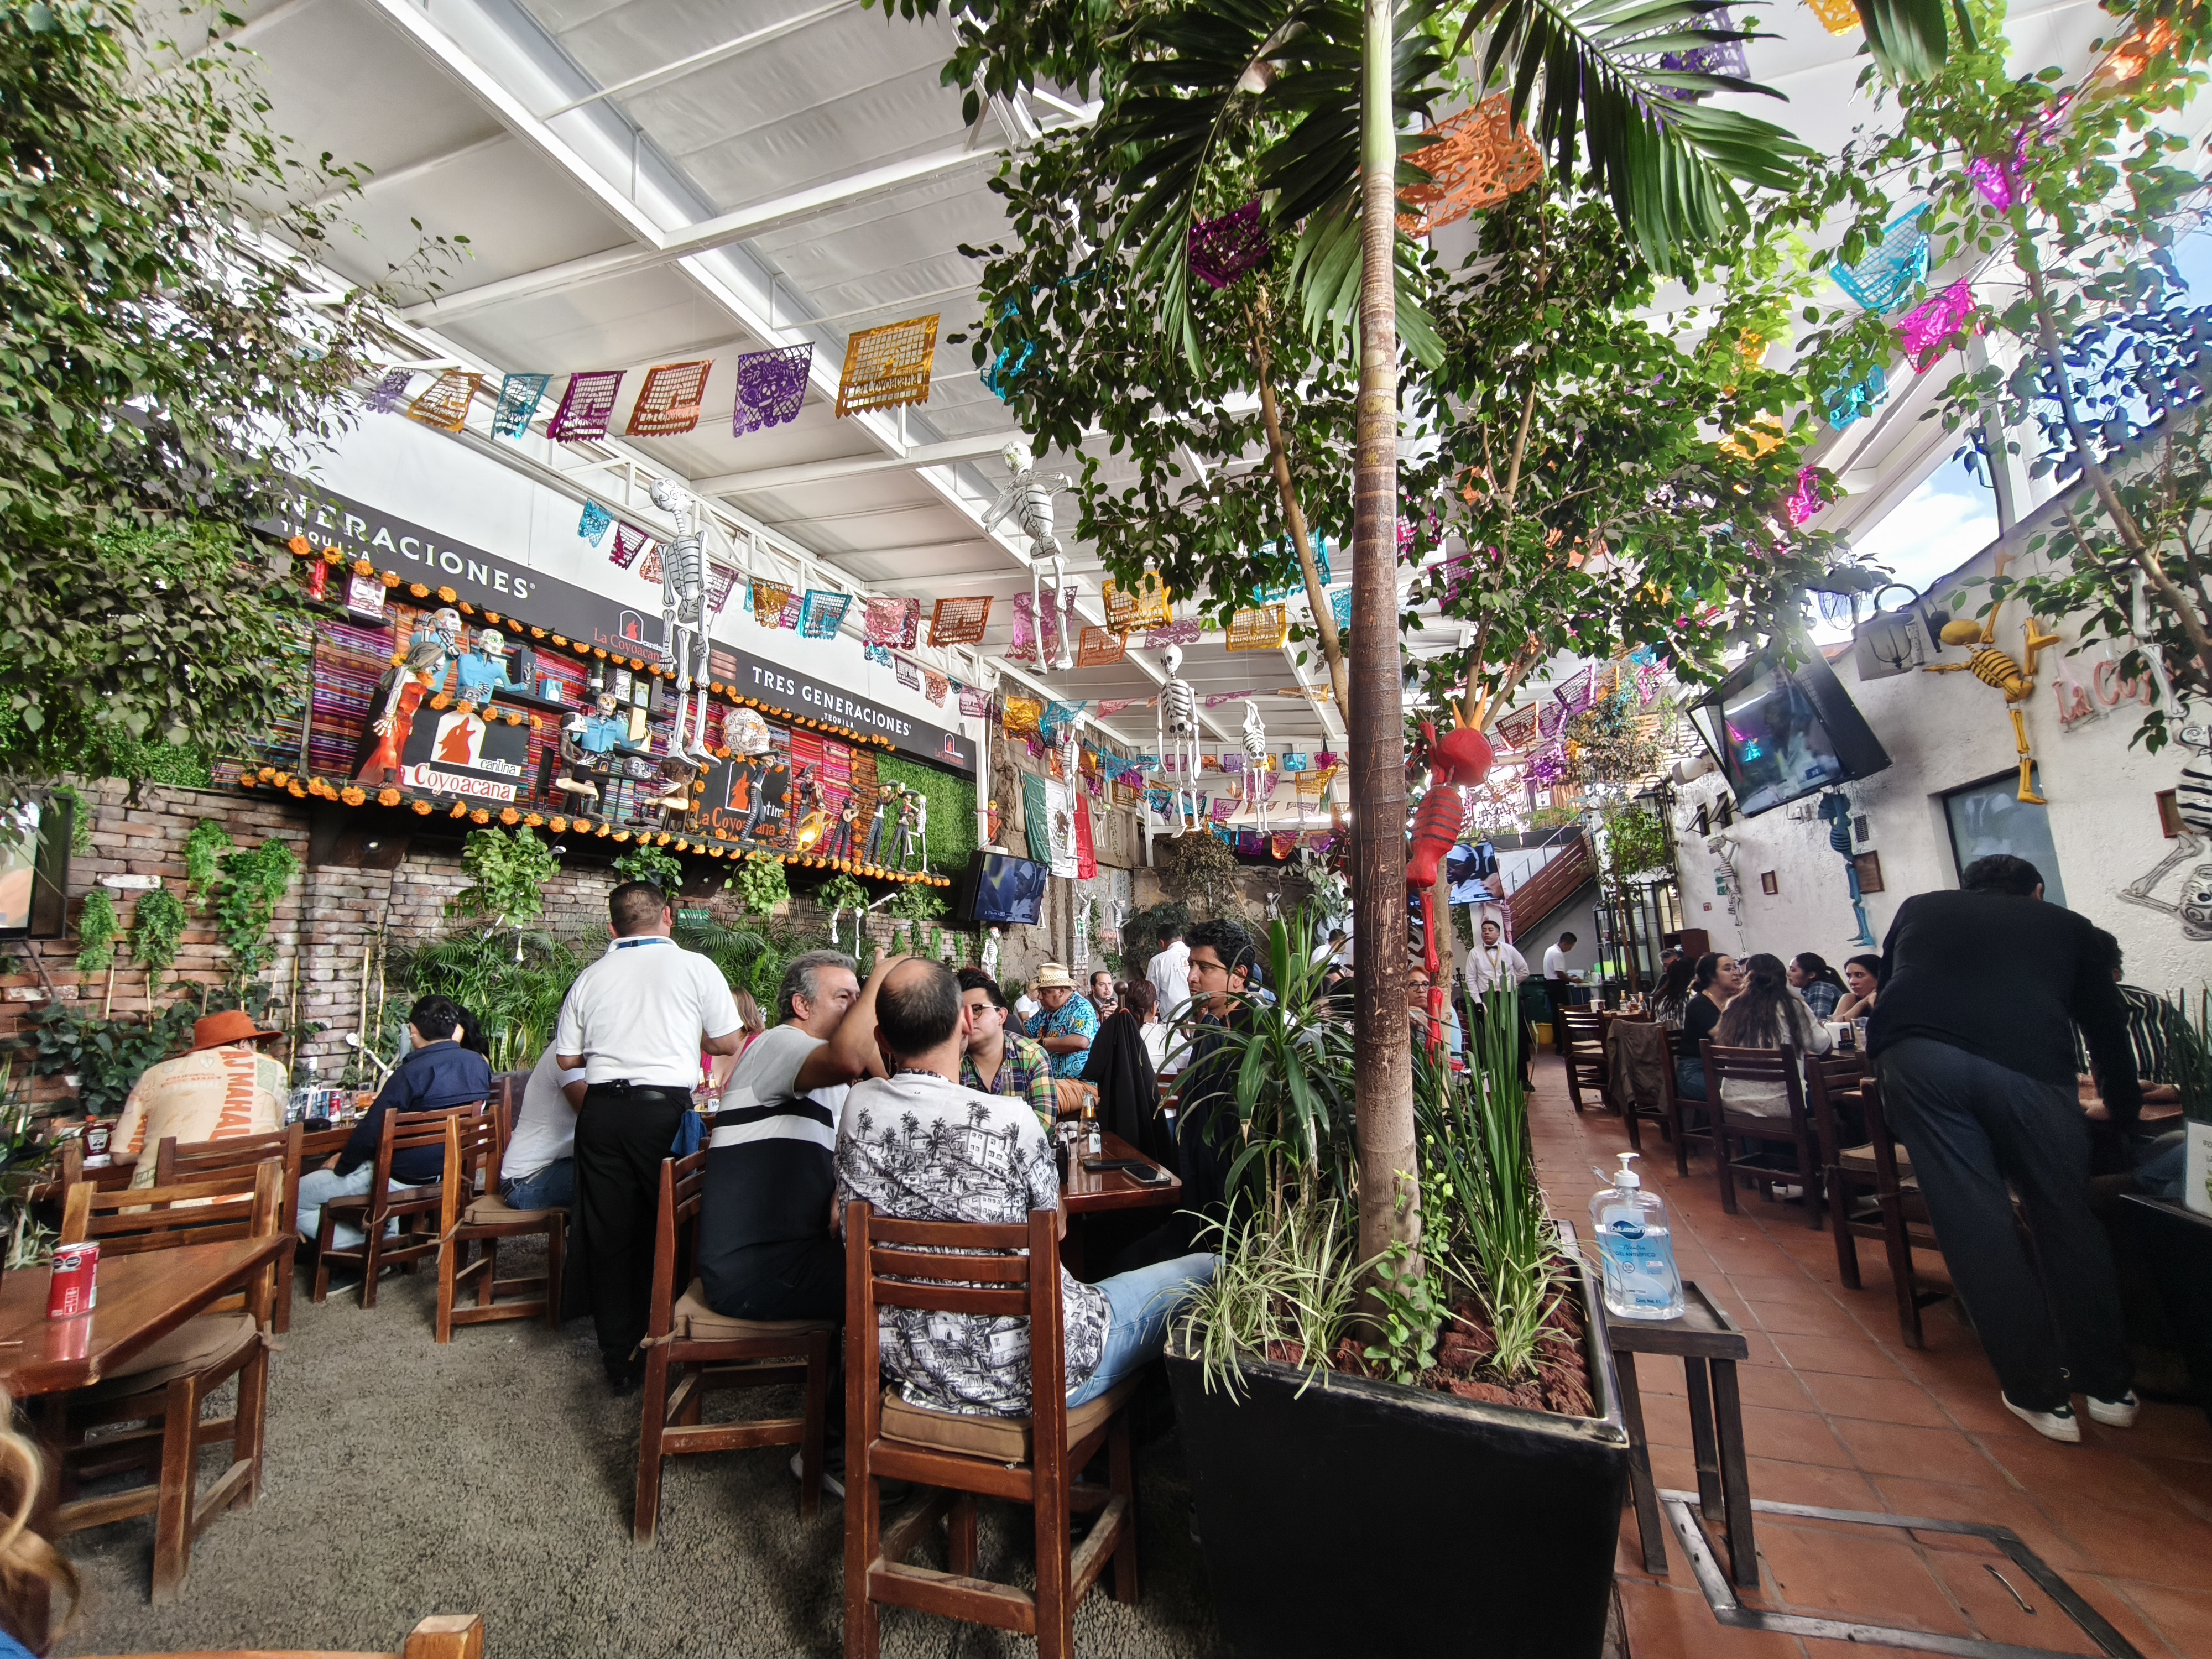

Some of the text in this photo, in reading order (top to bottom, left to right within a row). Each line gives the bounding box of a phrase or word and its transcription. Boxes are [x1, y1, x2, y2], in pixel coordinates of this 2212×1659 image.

[594, 627, 662, 662] La Coyoacan
[643, 640, 662, 651] cantin
[753, 666, 910, 737] TRES GENERACIONES
[824, 713, 854, 729] TEQUILA
[414, 764, 511, 797] Coyoacana
[480, 759, 516, 774] cantina
[712, 807, 775, 838] Coyoana
